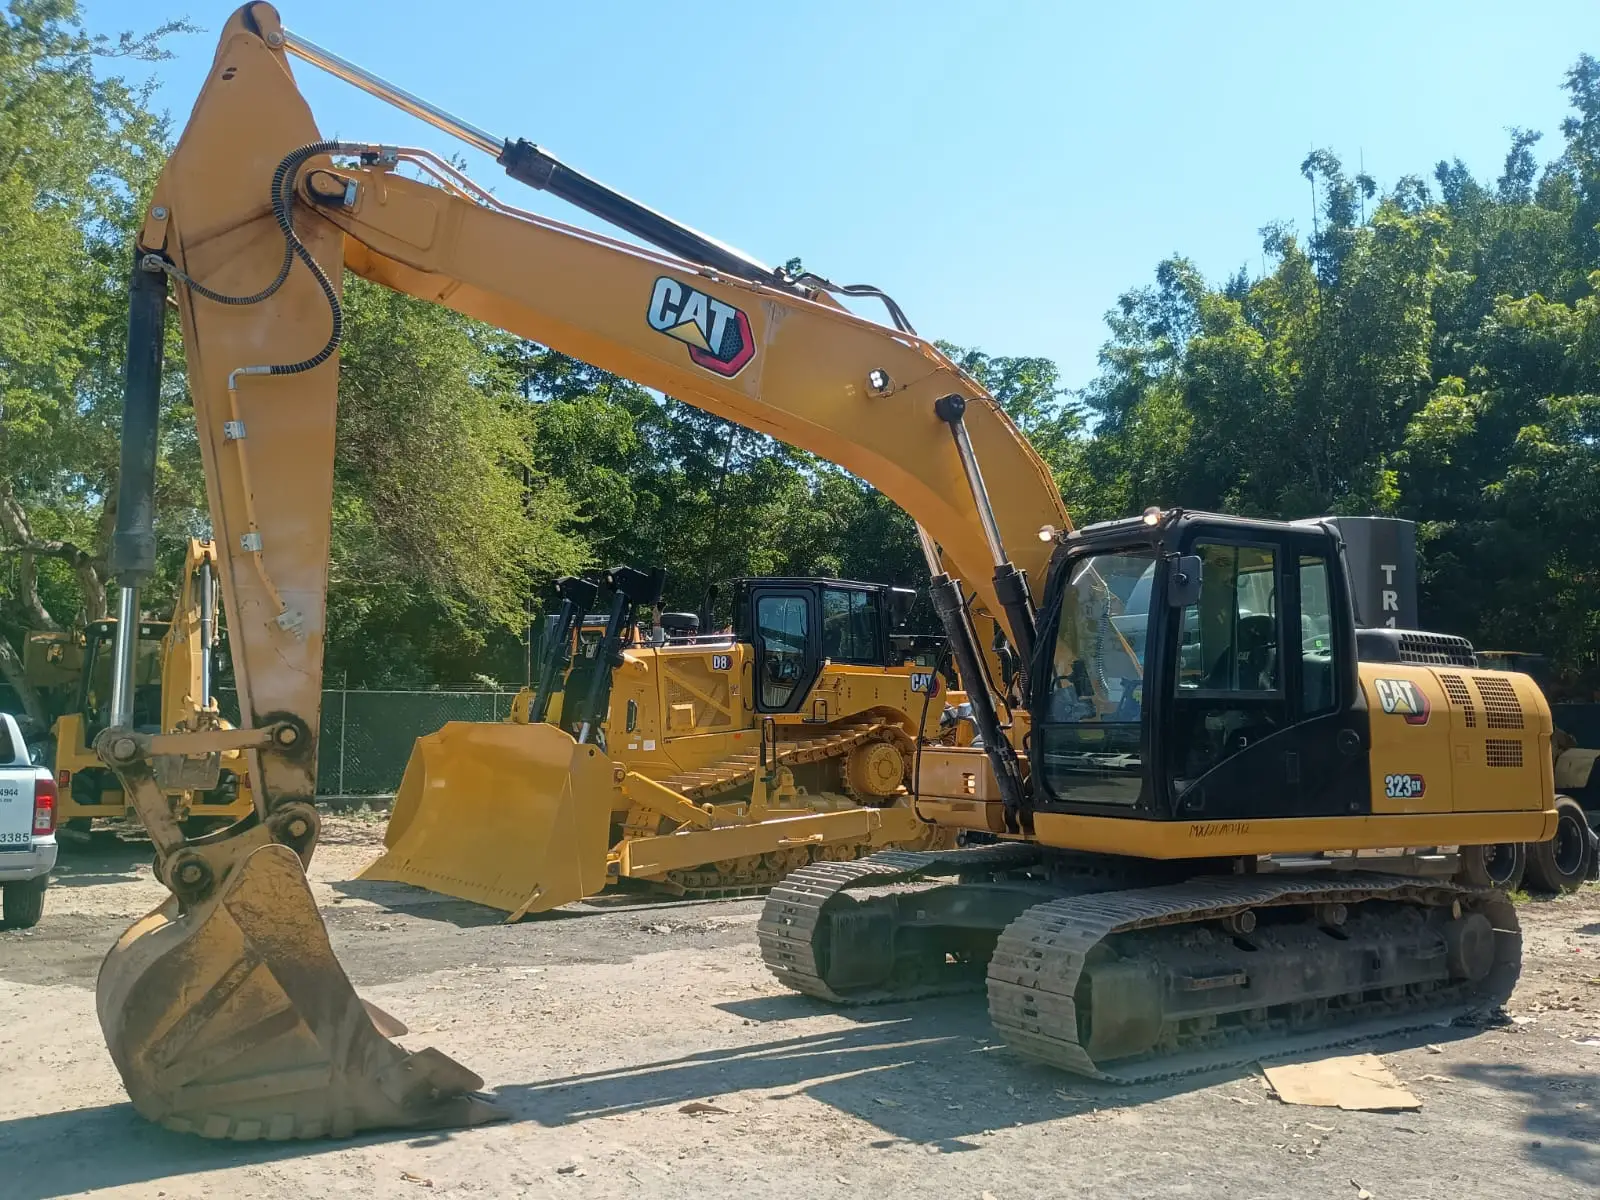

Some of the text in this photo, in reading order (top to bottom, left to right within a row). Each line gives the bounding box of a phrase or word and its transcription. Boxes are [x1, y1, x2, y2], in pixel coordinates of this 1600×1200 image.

[648, 277, 736, 355] CAT
[713, 655, 727, 669] D8
[1375, 679, 1418, 713] CAT
[0, 832, 30, 842] 3385
